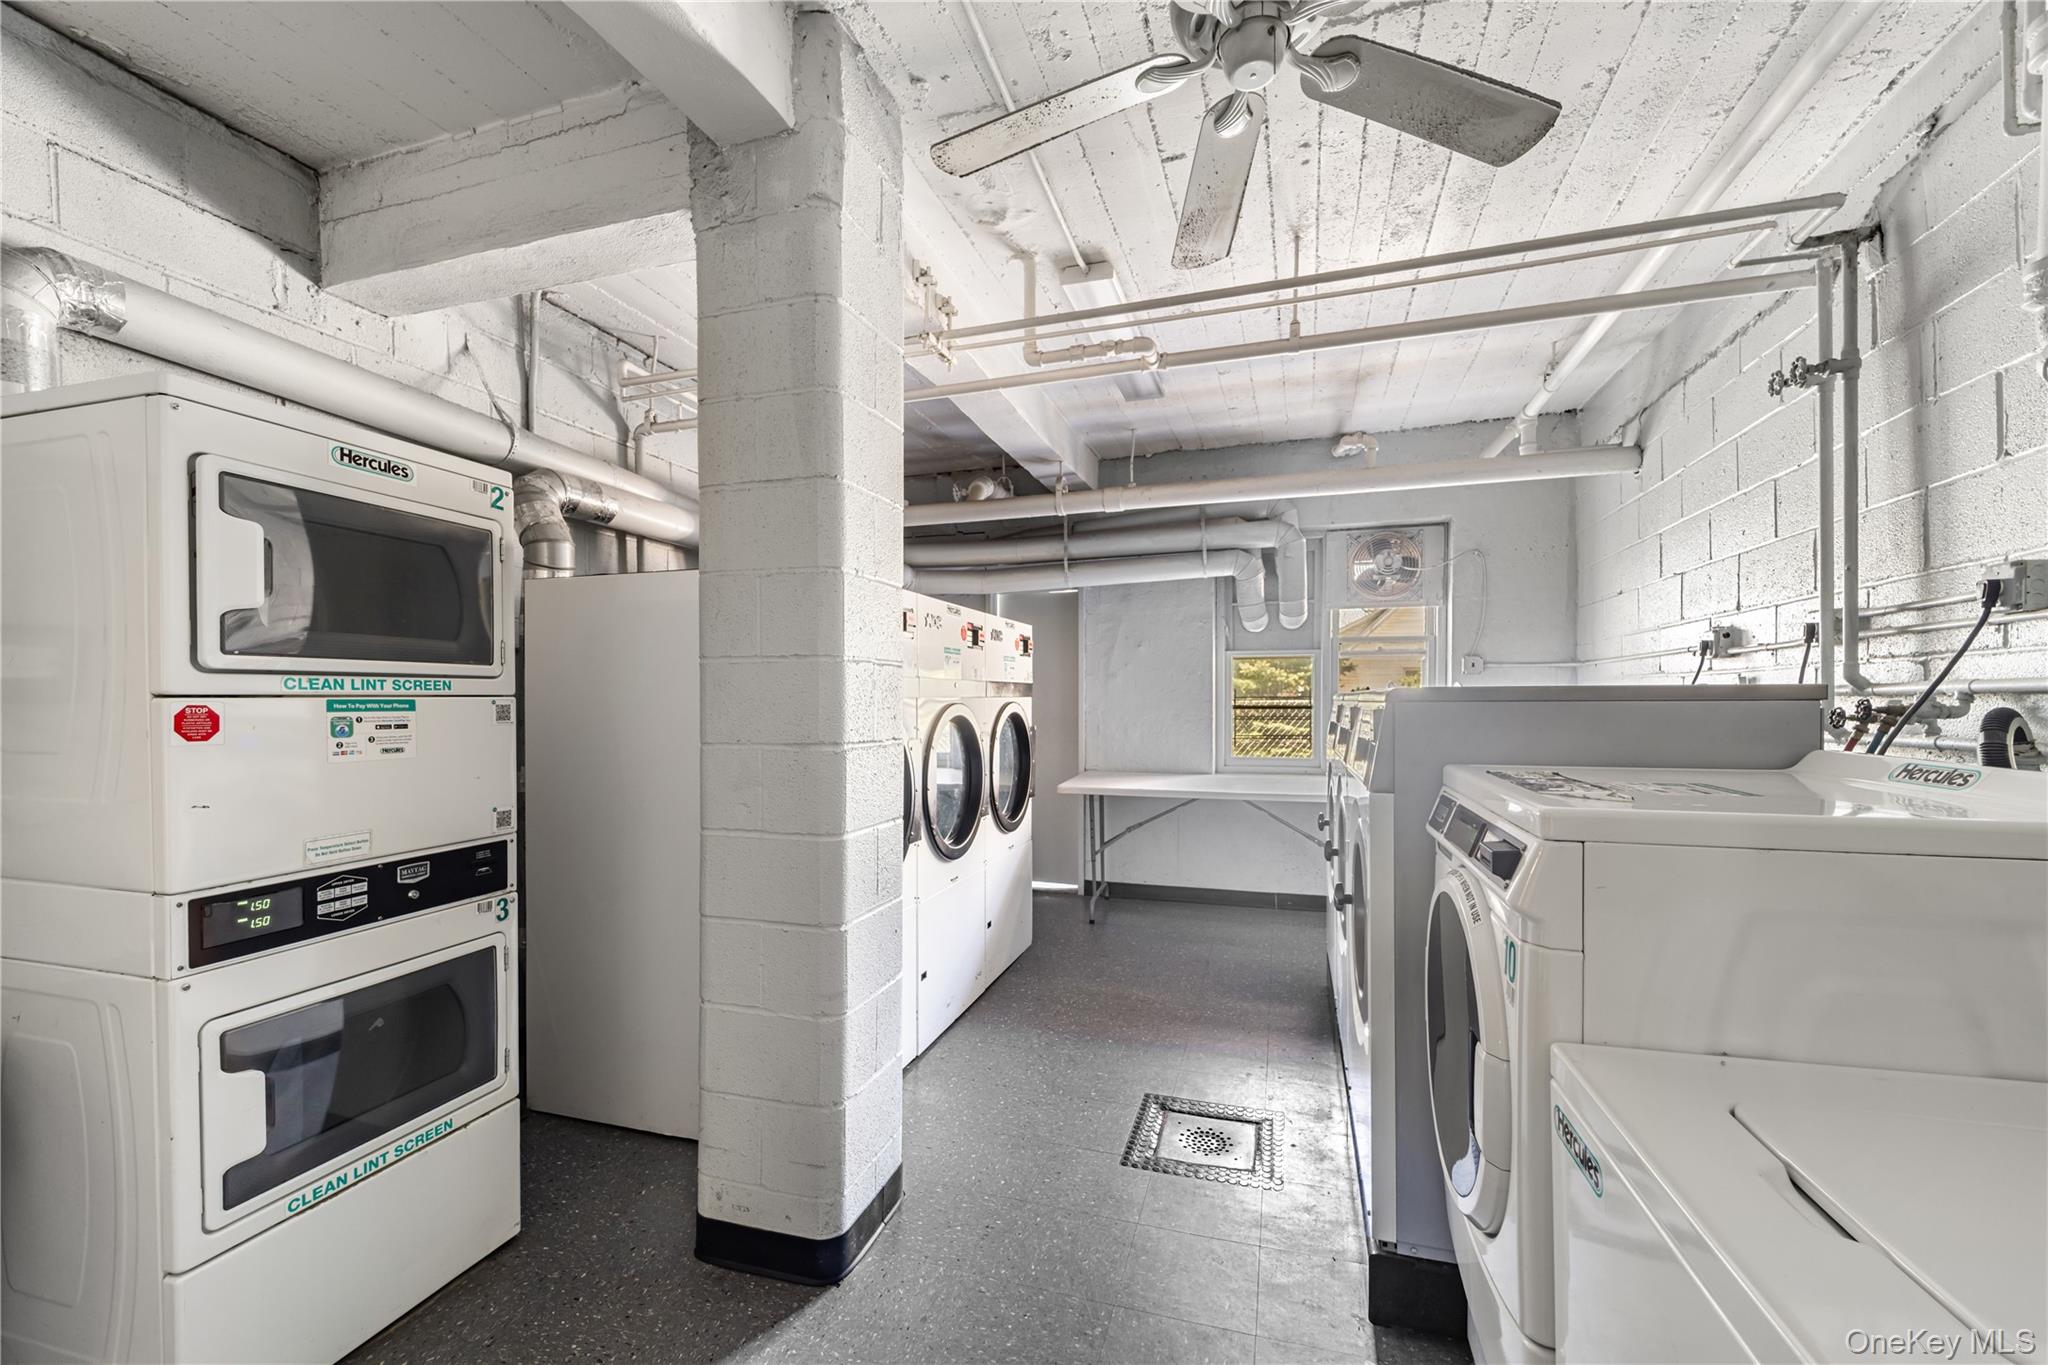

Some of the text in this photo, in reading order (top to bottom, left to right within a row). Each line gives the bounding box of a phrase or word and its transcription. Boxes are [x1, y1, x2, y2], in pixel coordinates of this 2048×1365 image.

[340, 447, 409, 478] Hercules
[490, 486, 504, 511] 2
[283, 677, 452, 691] CLEAN LINT SCREEN
[1895, 762, 1975, 787] Hercules
[401, 865, 427, 876] MAYTAG
[496, 897, 509, 922] 3
[1471, 909, 1482, 925] USE
[1504, 935, 1517, 984] 10
[1557, 1110, 1600, 1189] Hercules
[287, 1118, 454, 1213] CLEAN LINT SCREEN
